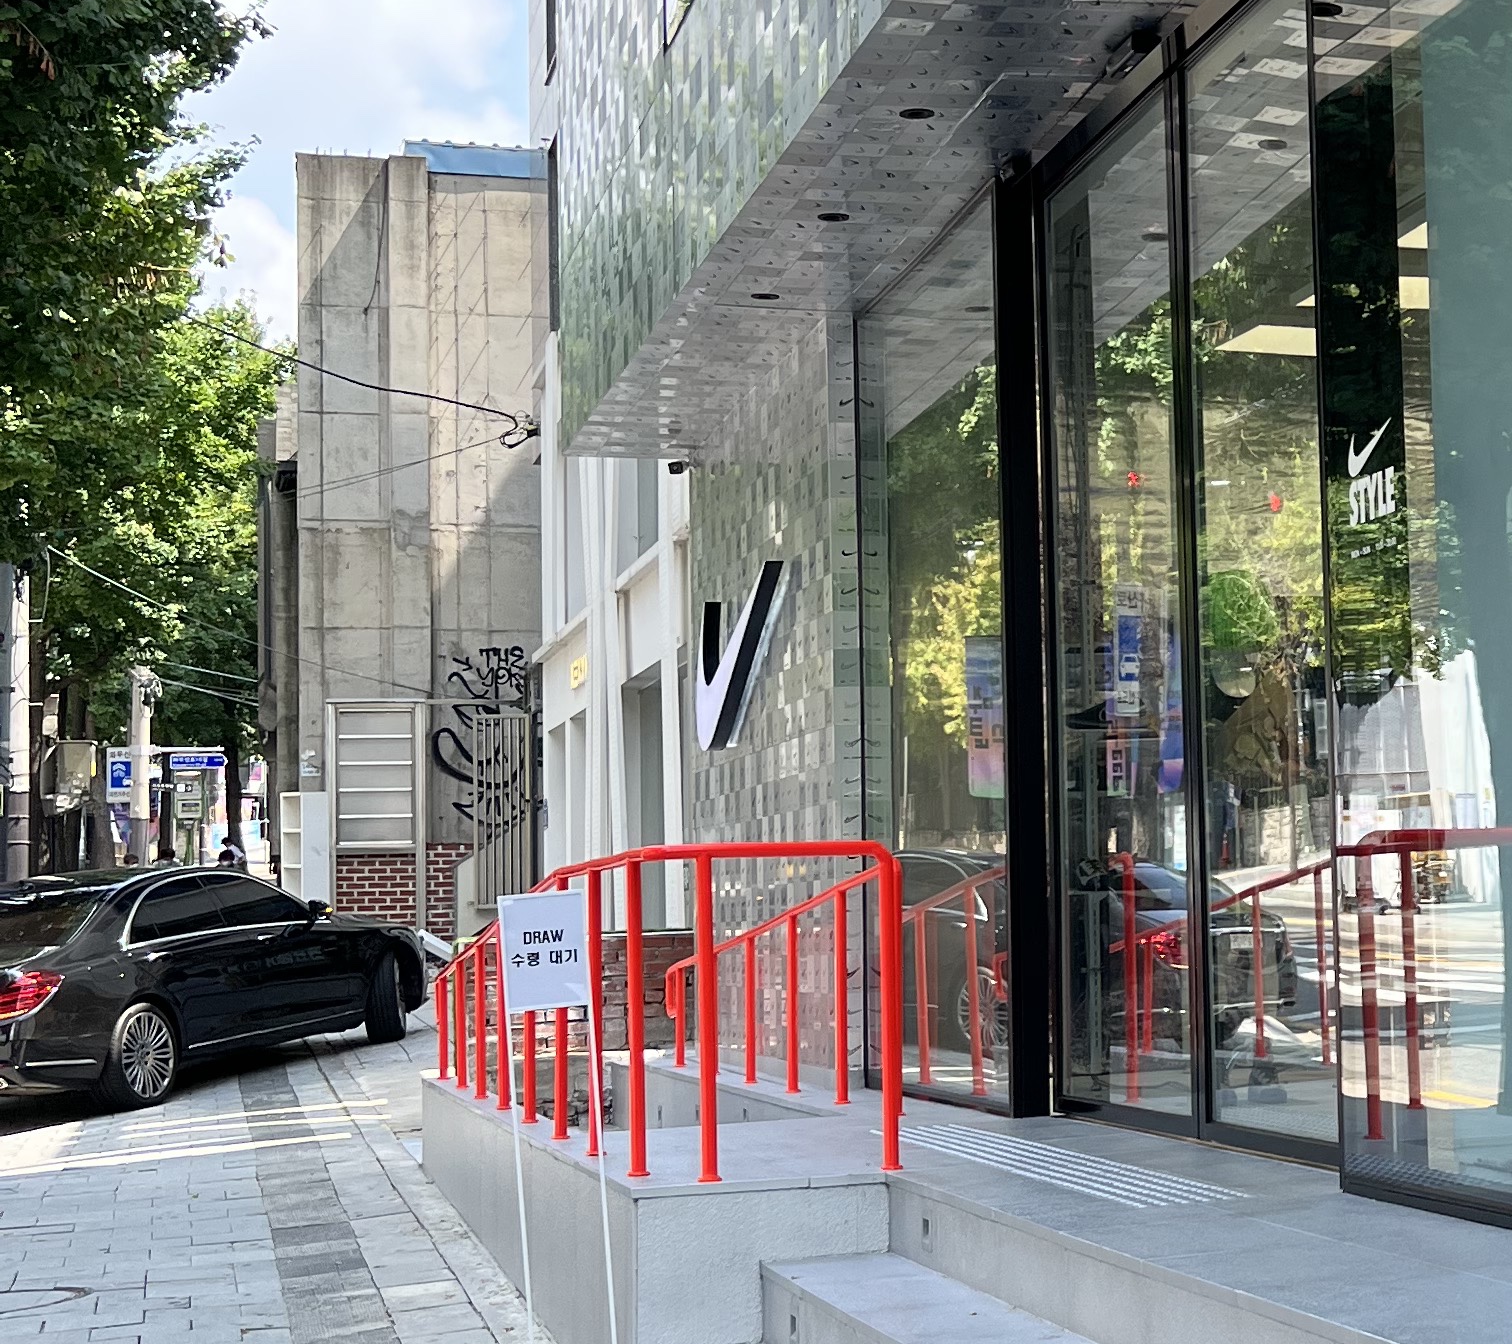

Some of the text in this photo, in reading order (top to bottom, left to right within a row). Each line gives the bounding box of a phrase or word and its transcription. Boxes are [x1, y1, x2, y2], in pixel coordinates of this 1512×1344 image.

[1349, 466, 1396, 528] STYLE
[479, 646, 525, 670] THE
[523, 929, 565, 945] DRAW
[511, 949, 578, 968] 수령 대기
